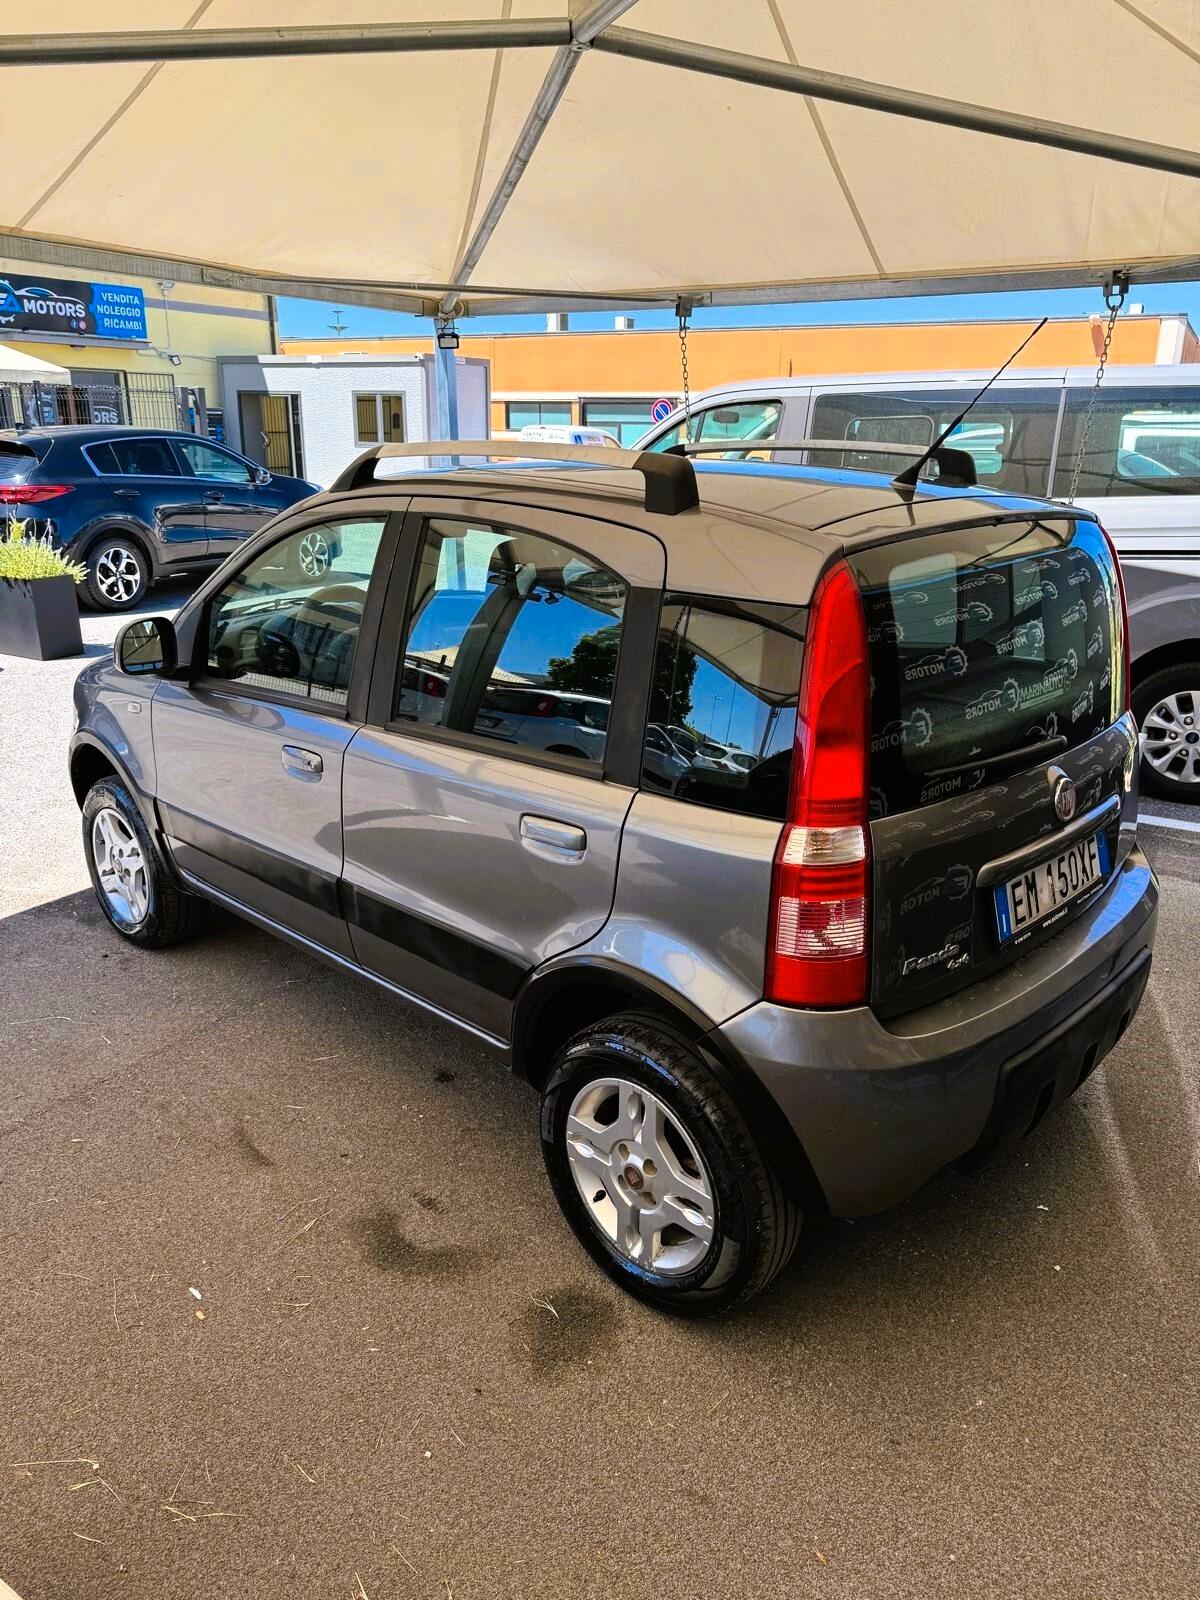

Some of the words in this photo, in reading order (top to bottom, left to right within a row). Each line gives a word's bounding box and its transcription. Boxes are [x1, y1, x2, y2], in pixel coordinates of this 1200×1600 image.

[101, 291, 140, 305] VENDITA
[23, 299, 86, 318] MOTORS
[96, 304, 141, 318] NOLEGGIO
[104, 318, 143, 331] RICAMBI
[1011, 870, 1040, 927] EM
[1046, 836, 1097, 905] 150XF
[902, 943, 960, 976] Panda
